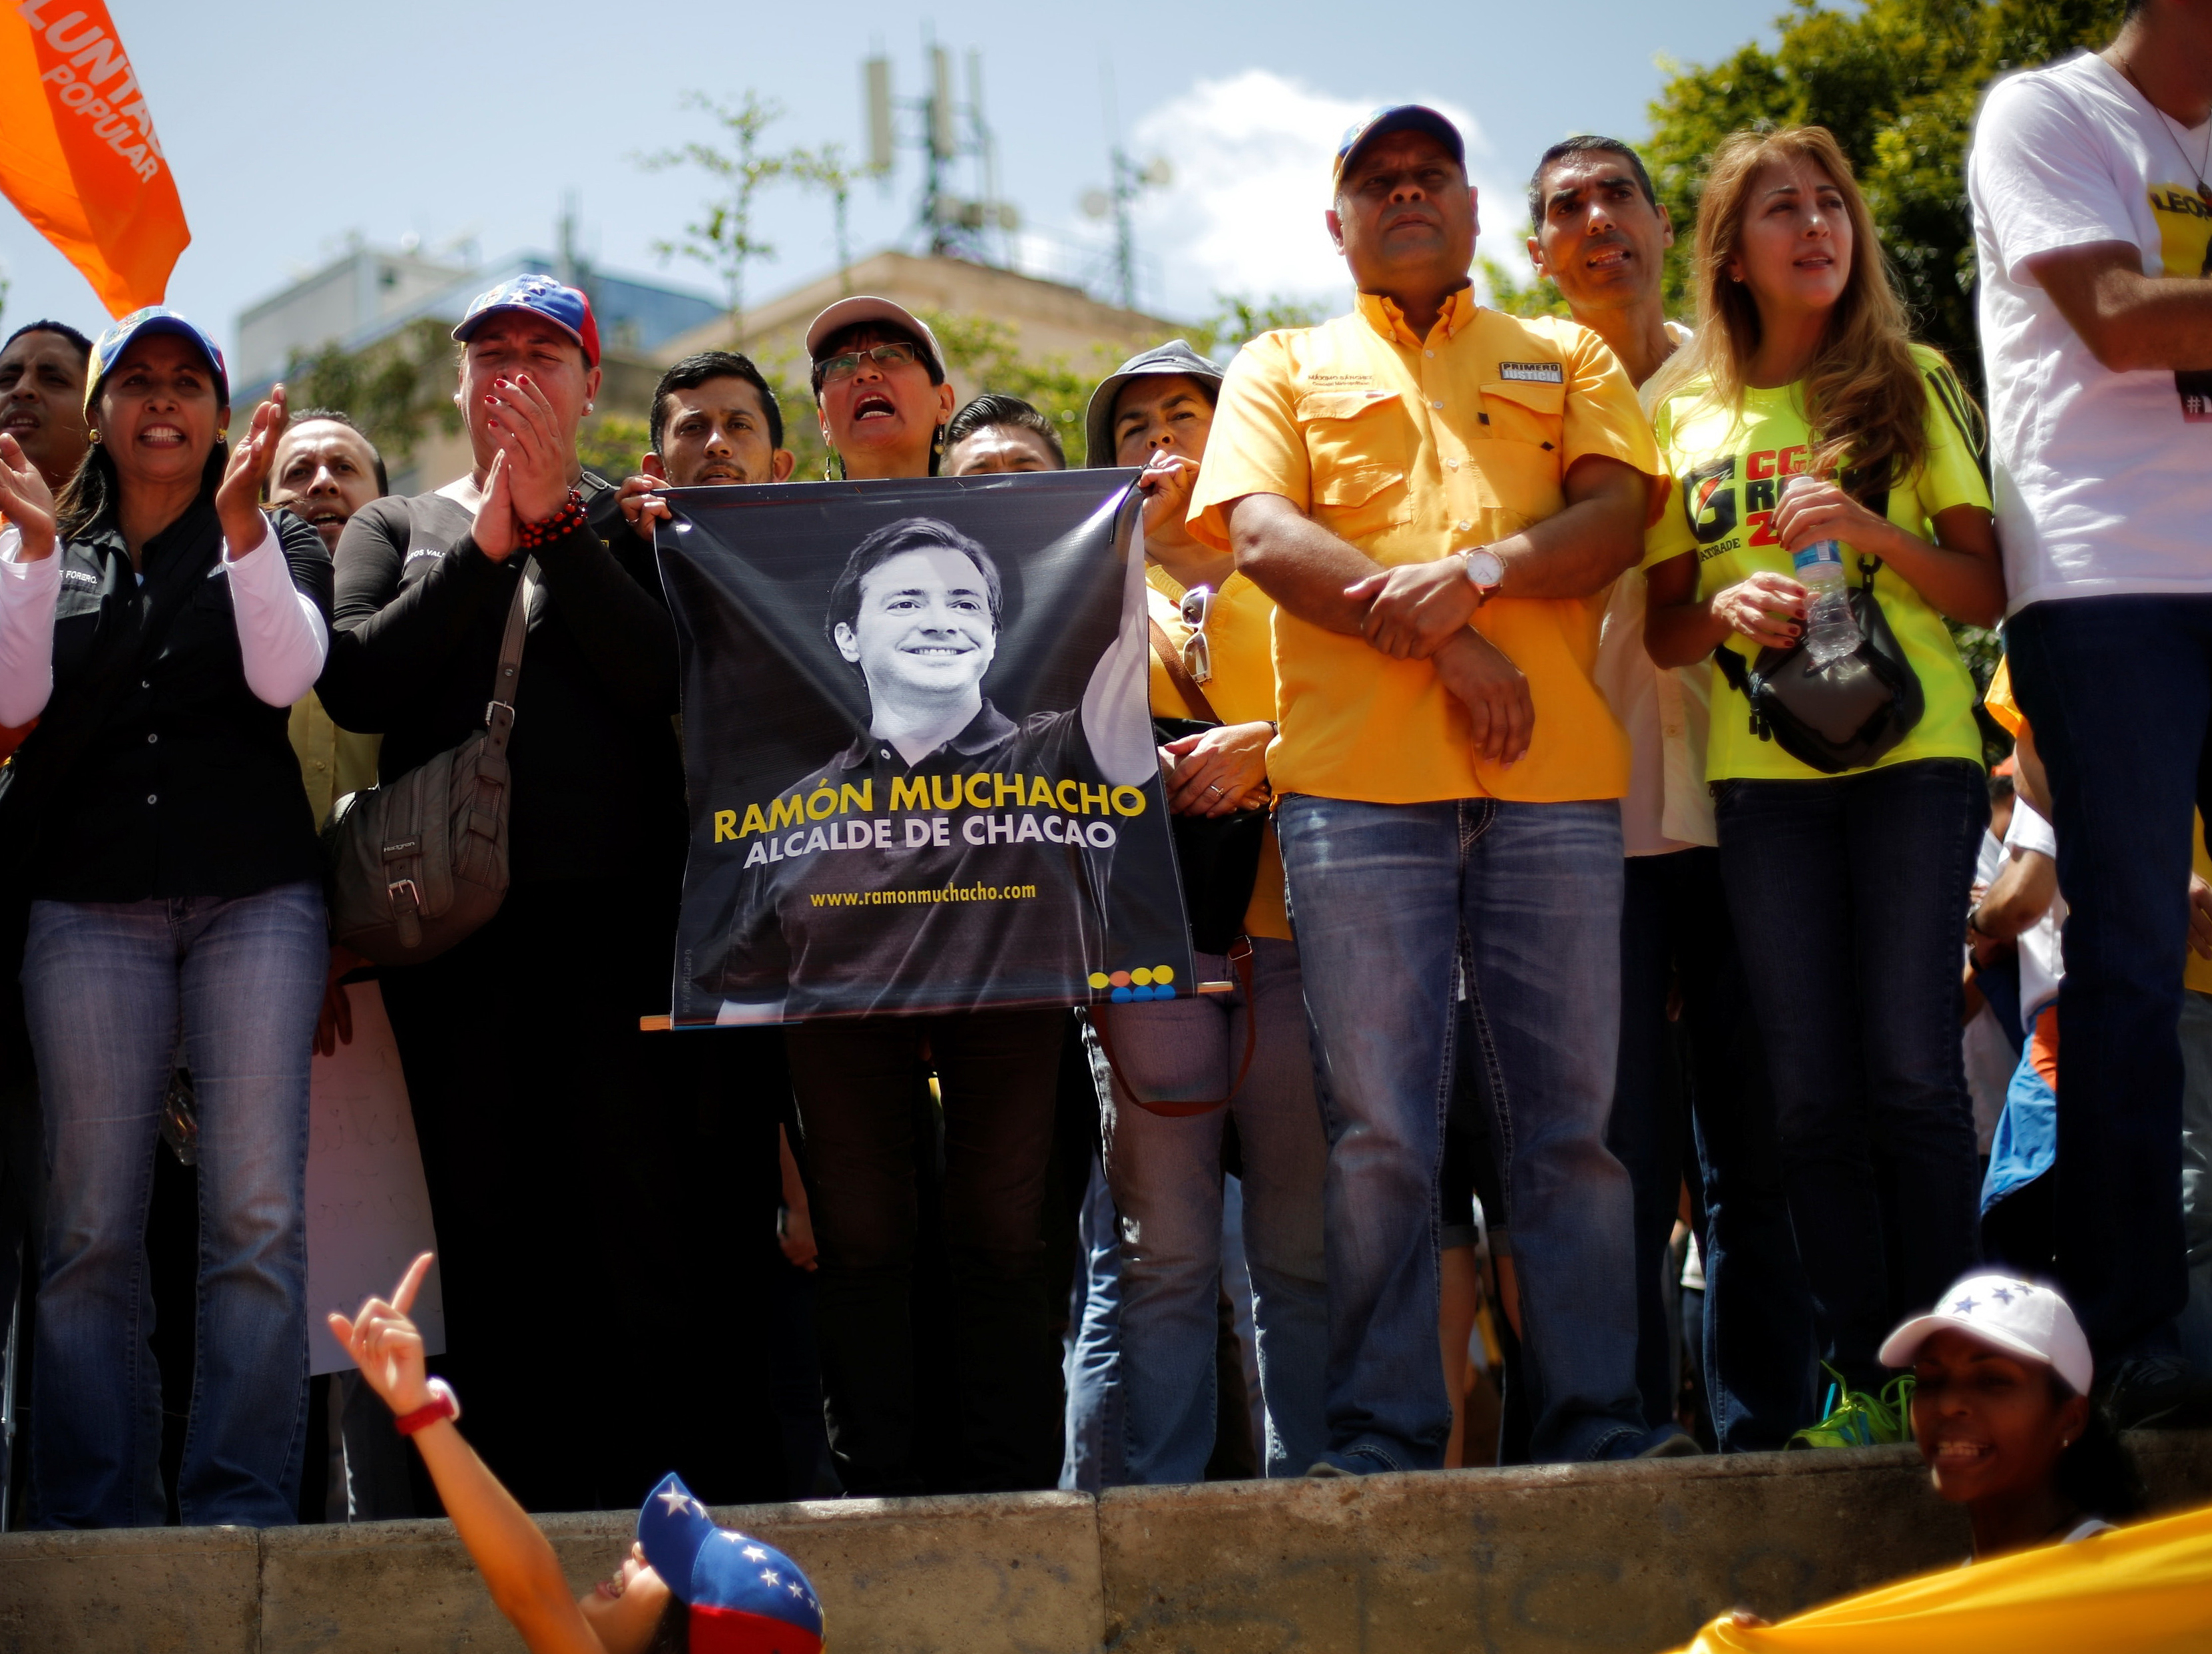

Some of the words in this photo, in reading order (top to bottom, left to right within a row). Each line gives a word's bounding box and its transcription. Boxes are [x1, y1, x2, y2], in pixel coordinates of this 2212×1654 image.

[40, 63, 159, 184] POPULAR
[1503, 370, 1561, 382] JUSTICIA
[1699, 537, 1741, 563] ATORADE
[714, 778, 873, 844] RAMÓN
[889, 772, 1146, 816] MUCHACHO
[742, 818, 892, 869] ALCALDE
[904, 817, 951, 848] DE
[962, 814, 1116, 848] CHACAO
[810, 880, 1036, 907] www.ramonmuchacho.com
